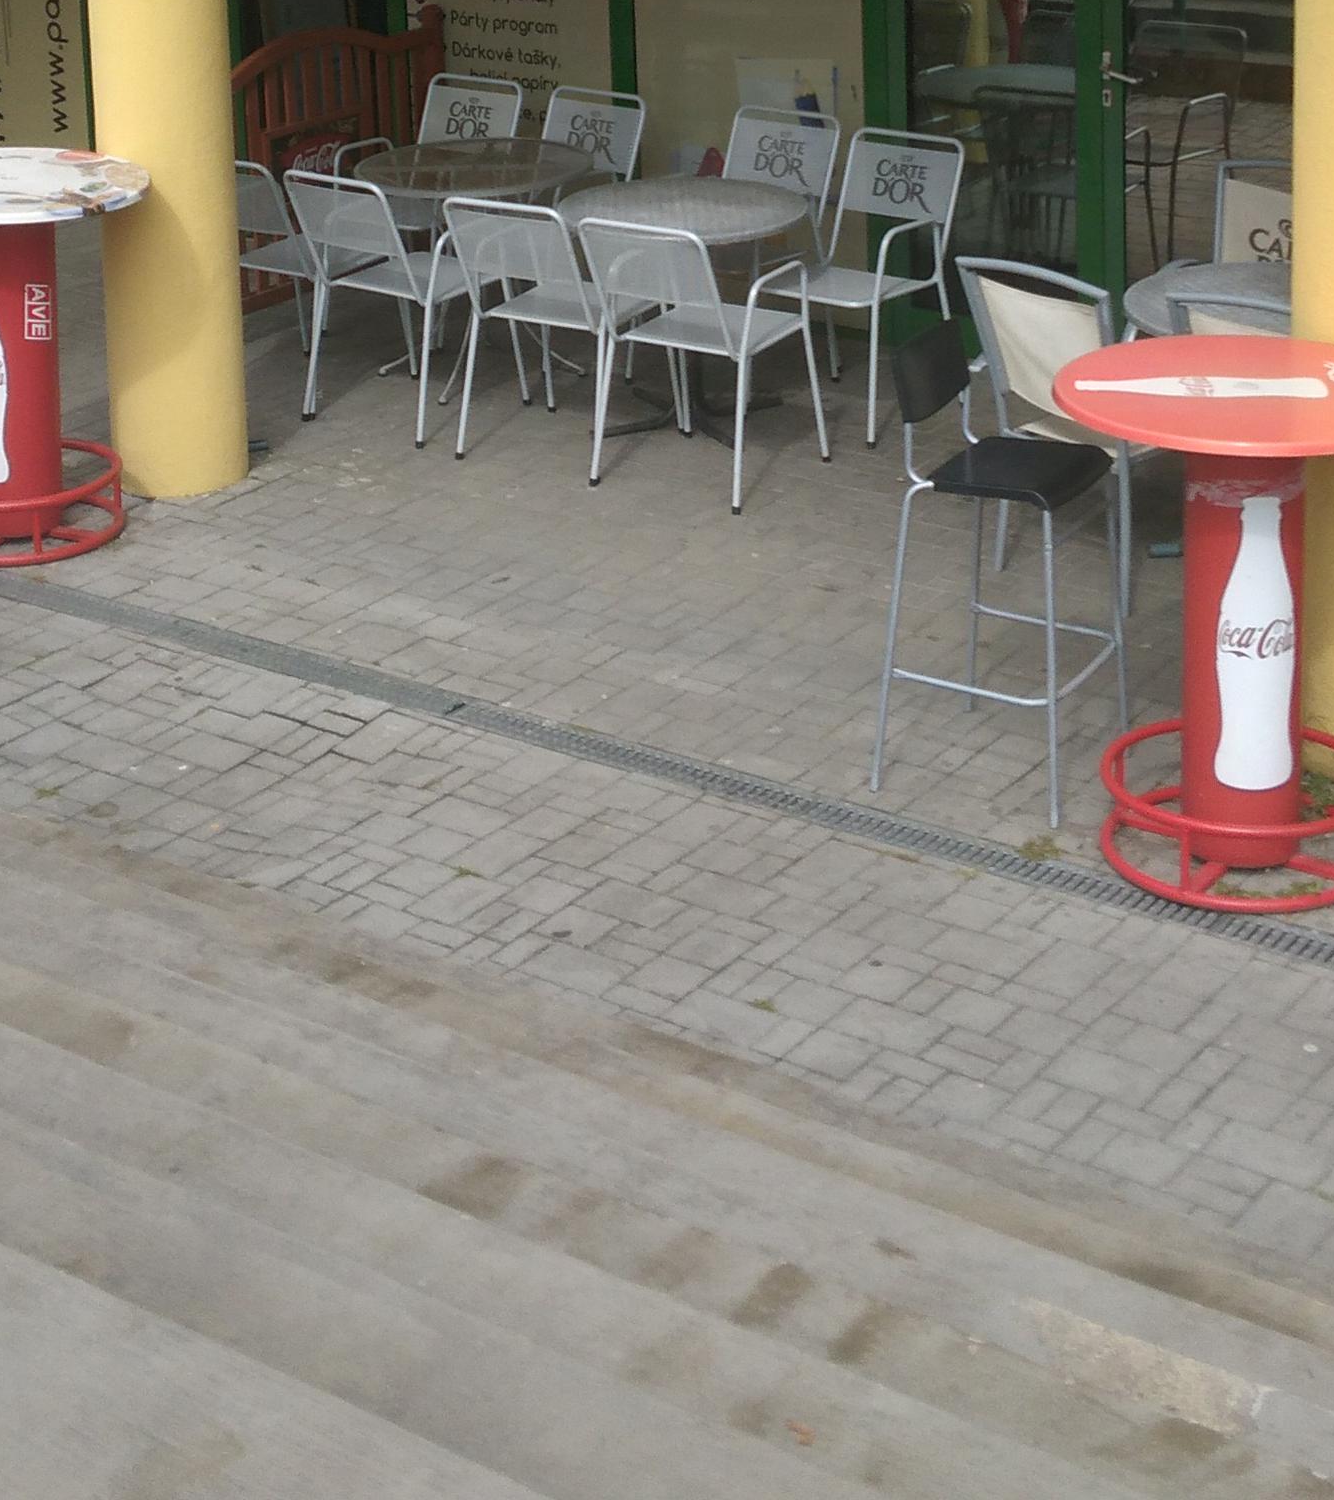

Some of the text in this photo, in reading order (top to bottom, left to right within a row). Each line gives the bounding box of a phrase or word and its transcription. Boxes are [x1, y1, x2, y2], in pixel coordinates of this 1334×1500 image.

[450, 9, 558, 36] Párty program
[452, 41, 561, 69] Dárkové tašky,
[449, 101, 493, 120] CARTE
[570, 114, 615, 135] CARTE
[292, 141, 341, 172] Coca-Col
[758, 135, 806, 156] CARTE
[876, 158, 929, 181] CARTE
[30, 286, 48, 337] AVE
